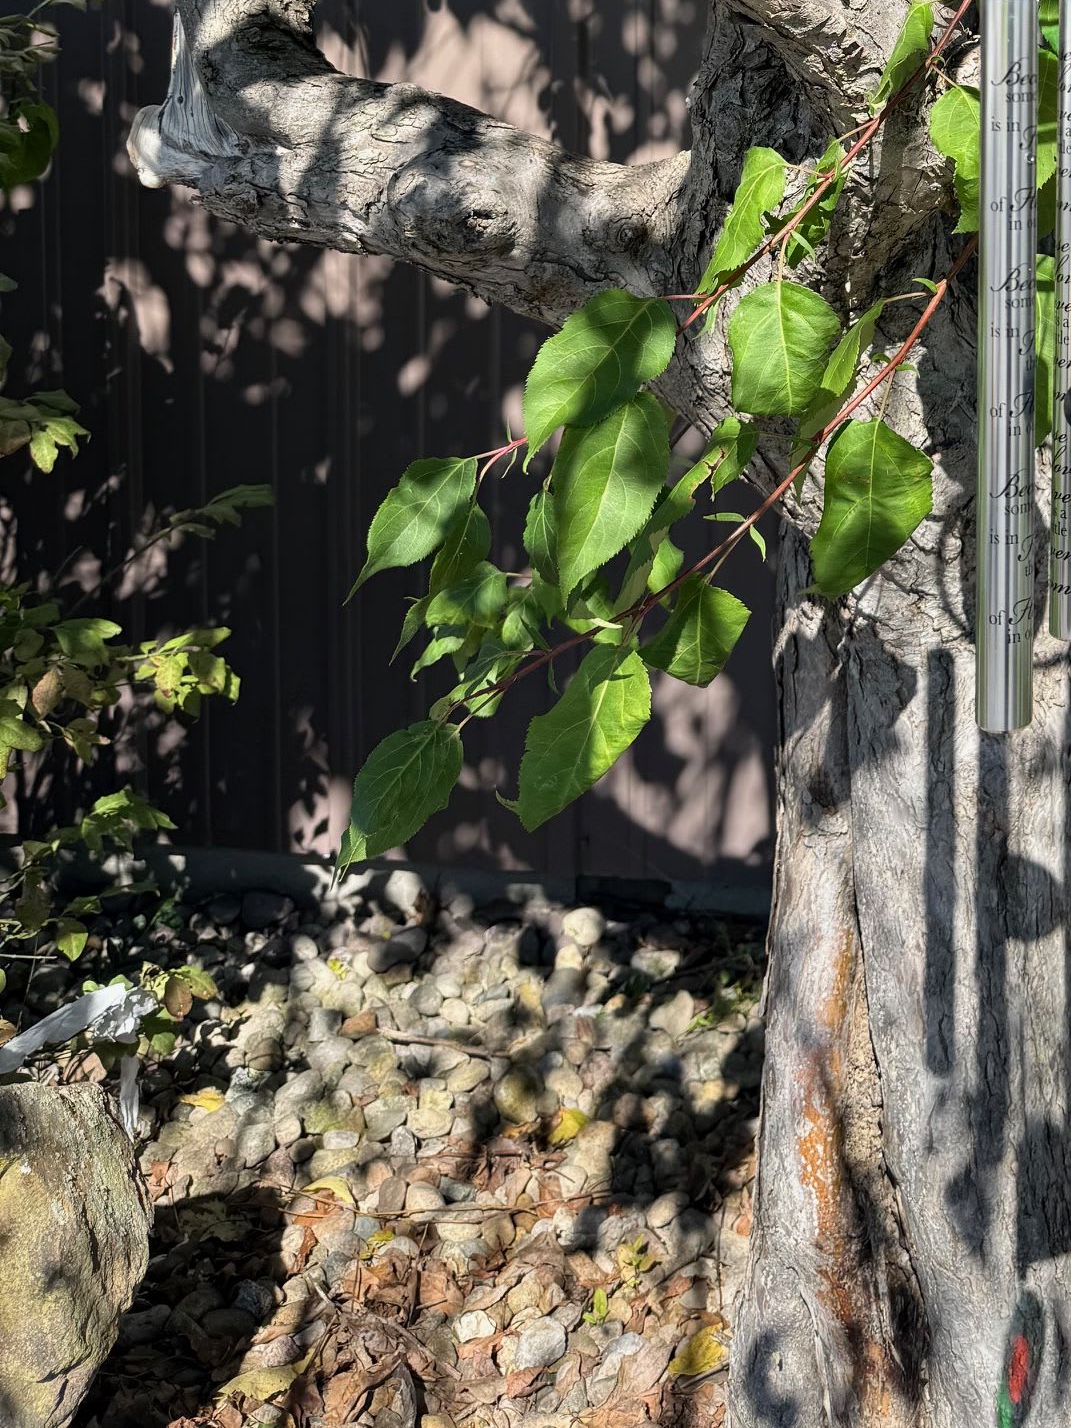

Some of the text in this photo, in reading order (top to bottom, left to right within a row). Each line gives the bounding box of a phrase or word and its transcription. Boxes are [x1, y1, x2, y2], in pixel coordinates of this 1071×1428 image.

[990, 116, 1021, 132] is in
[990, 196, 1007, 212] of
[1008, 214, 1022, 230] in
[990, 322, 1020, 338] is in
[990, 403, 1006, 418] of
[1008, 421, 1022, 437] in
[990, 528, 1019, 545] is in
[989, 610, 1006, 625] of
[1007, 628, 1021, 644] in
